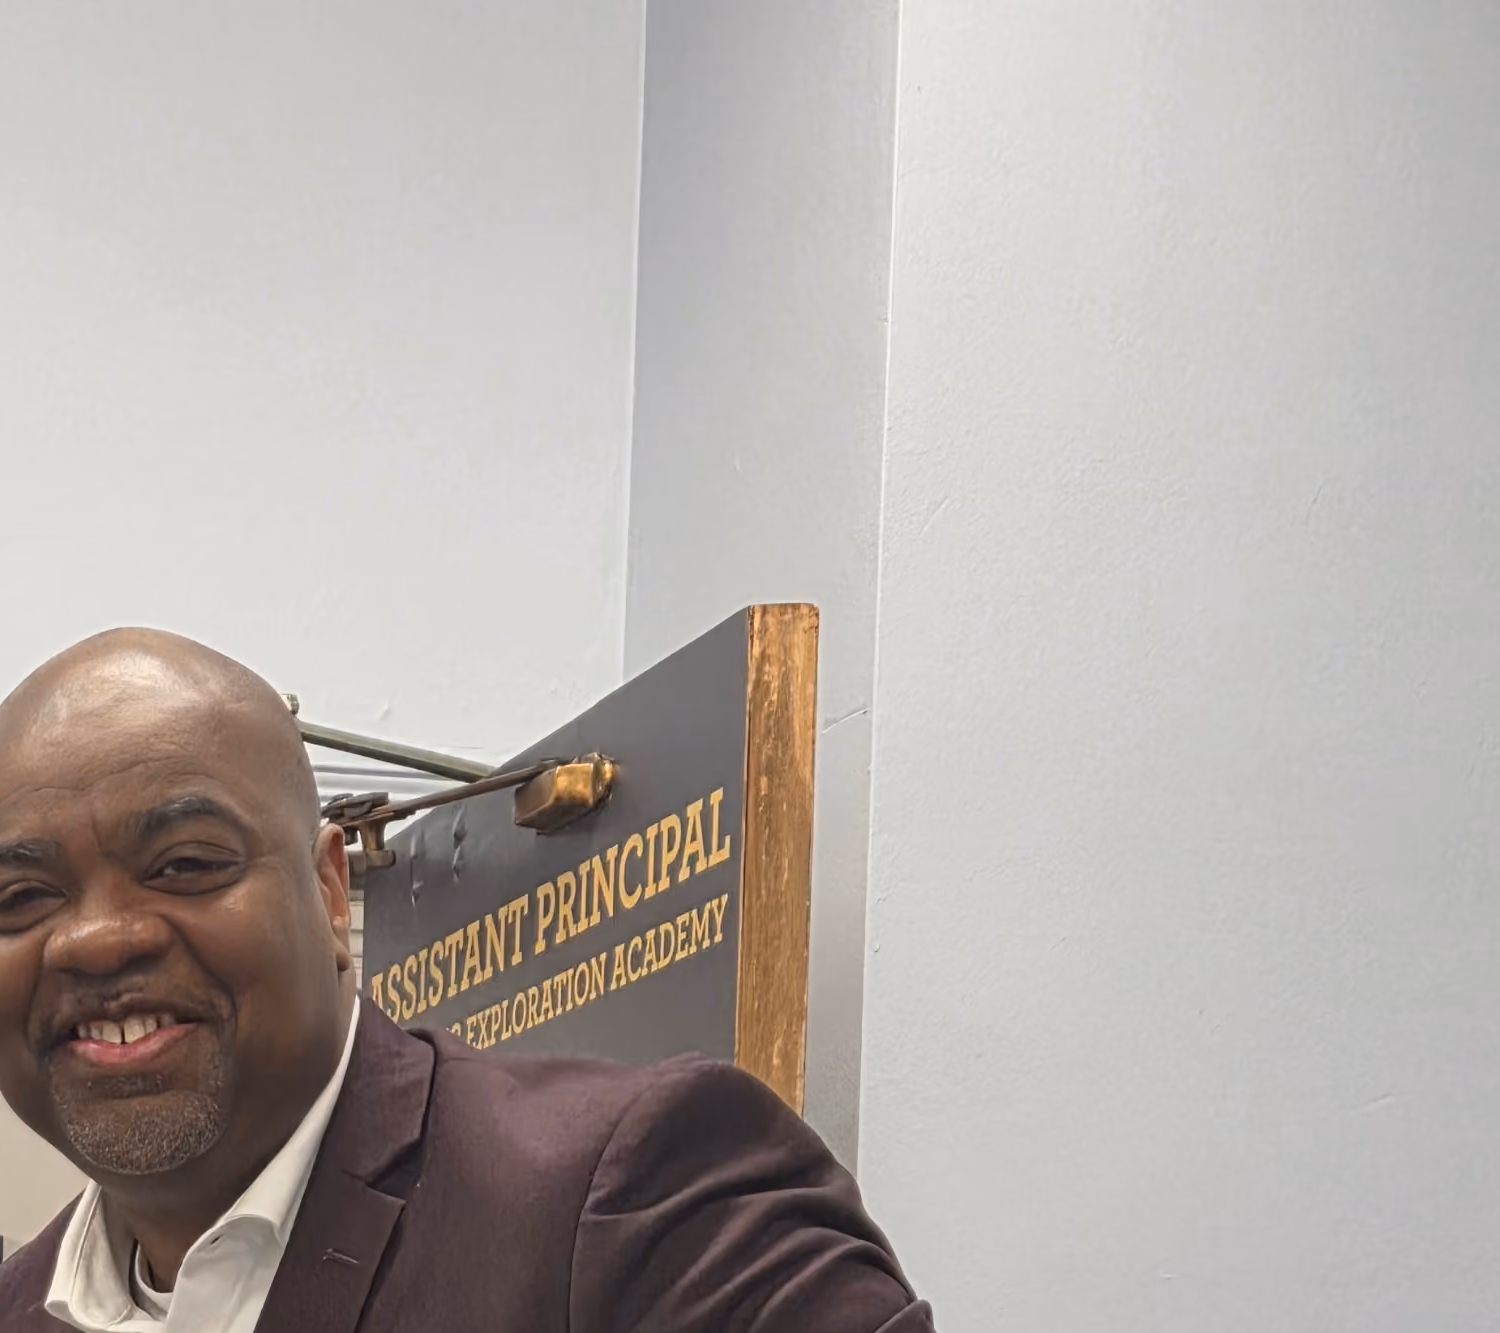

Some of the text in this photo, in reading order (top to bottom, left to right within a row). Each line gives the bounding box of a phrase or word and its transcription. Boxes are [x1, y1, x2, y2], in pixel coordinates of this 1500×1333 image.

[372, 787, 731, 1024] ASSISTANT PRINCIPAL
[466, 894, 729, 1051] EXPLORATION ACADEMY
